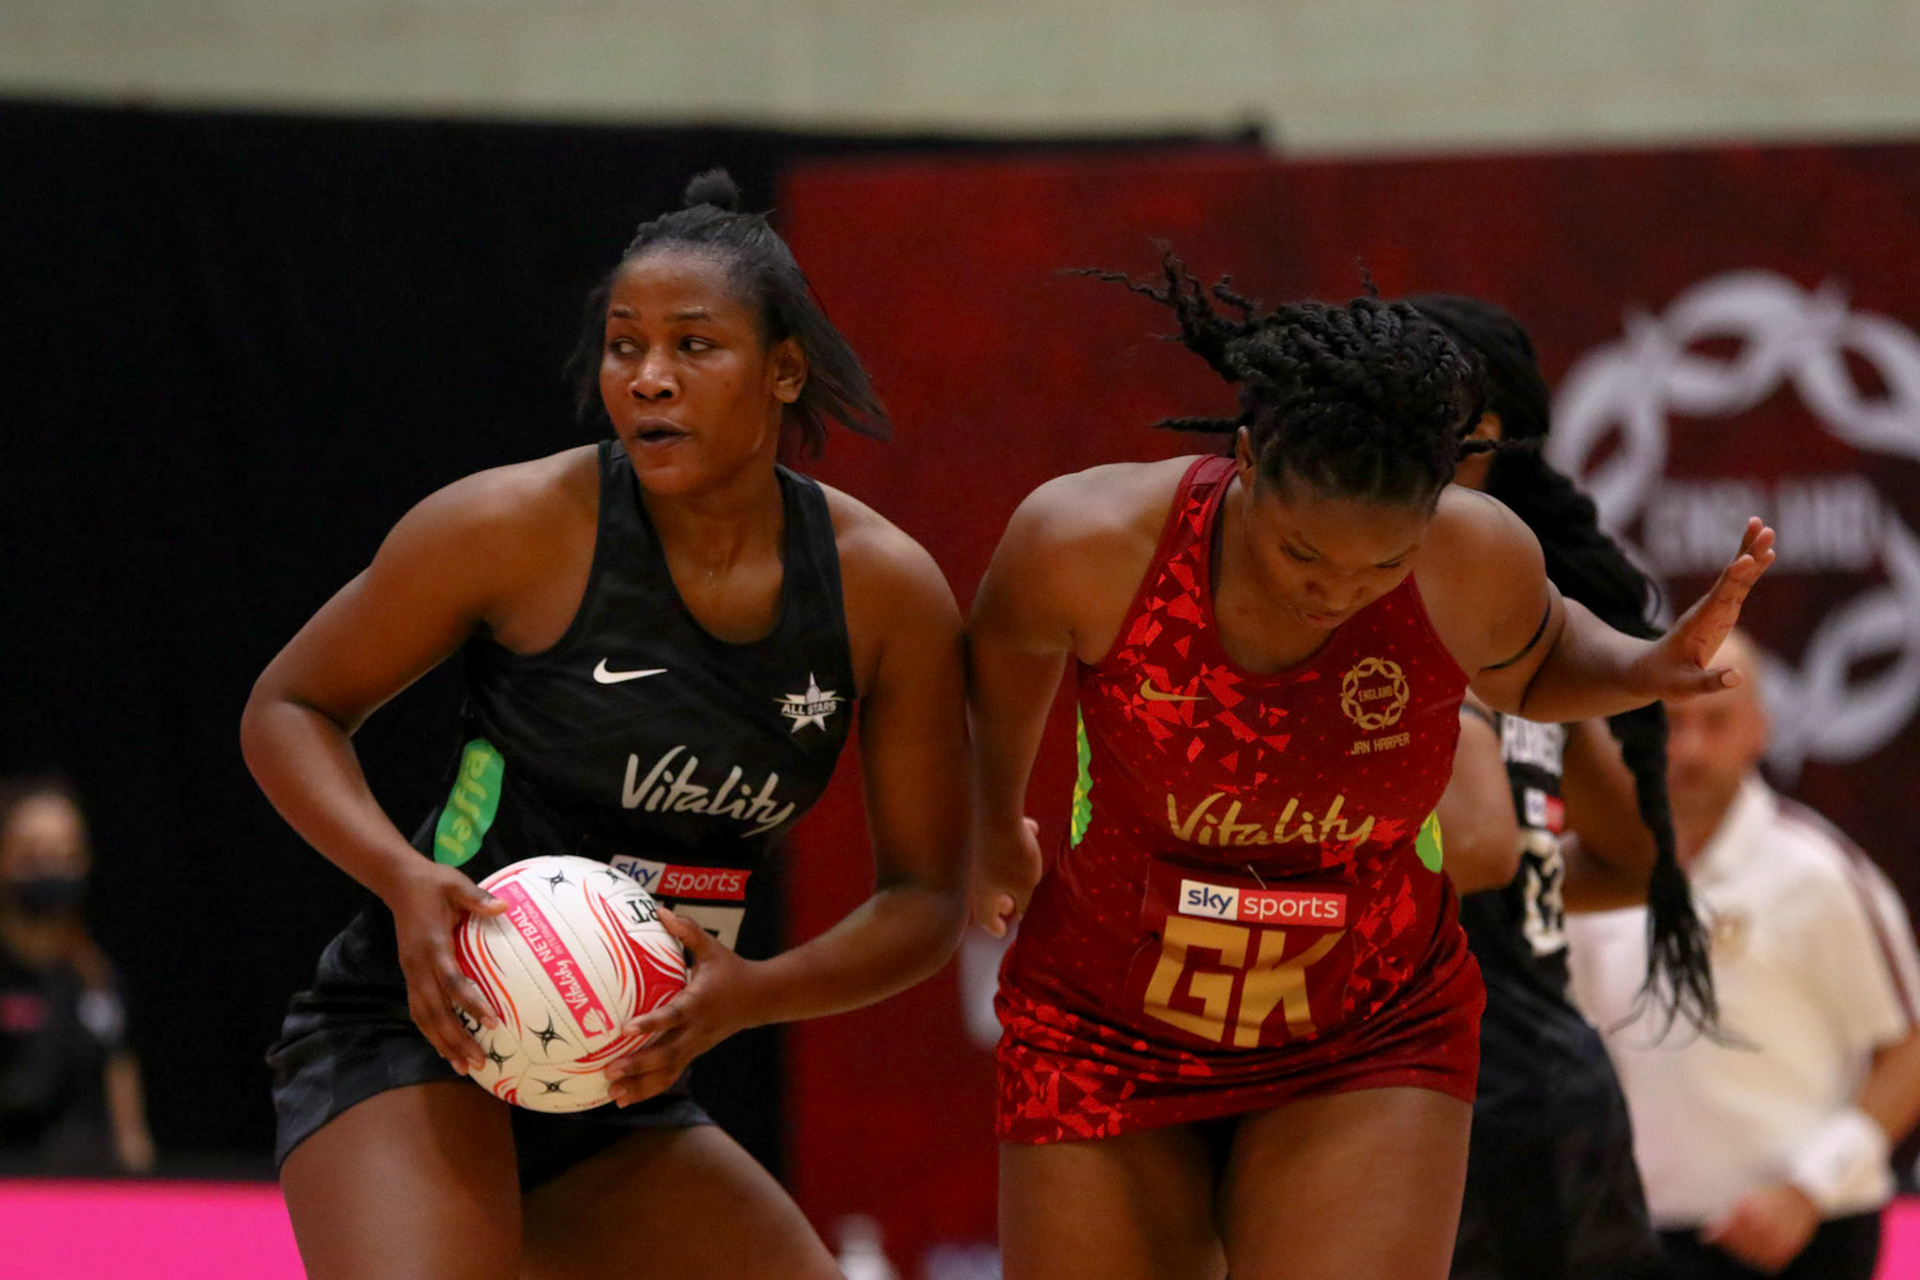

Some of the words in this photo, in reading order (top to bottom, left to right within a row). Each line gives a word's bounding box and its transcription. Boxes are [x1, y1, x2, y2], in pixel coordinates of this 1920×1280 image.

[781, 703, 805, 716] ALL
[807, 700, 837, 716] STARS
[1358, 685, 1394, 702] ENGLAND
[1350, 741, 1370, 755] JAN
[1373, 732, 1410, 752] HARPER
[622, 745, 796, 838] Vitality
[1167, 791, 1376, 847] Vitality
[663, 872, 742, 895] sports
[1187, 887, 1233, 915] sky
[1243, 896, 1339, 920] sports
[509, 905, 555, 963] NETBALL
[554, 958, 589, 1011] Vitality
[1143, 915, 1347, 1048] GK
